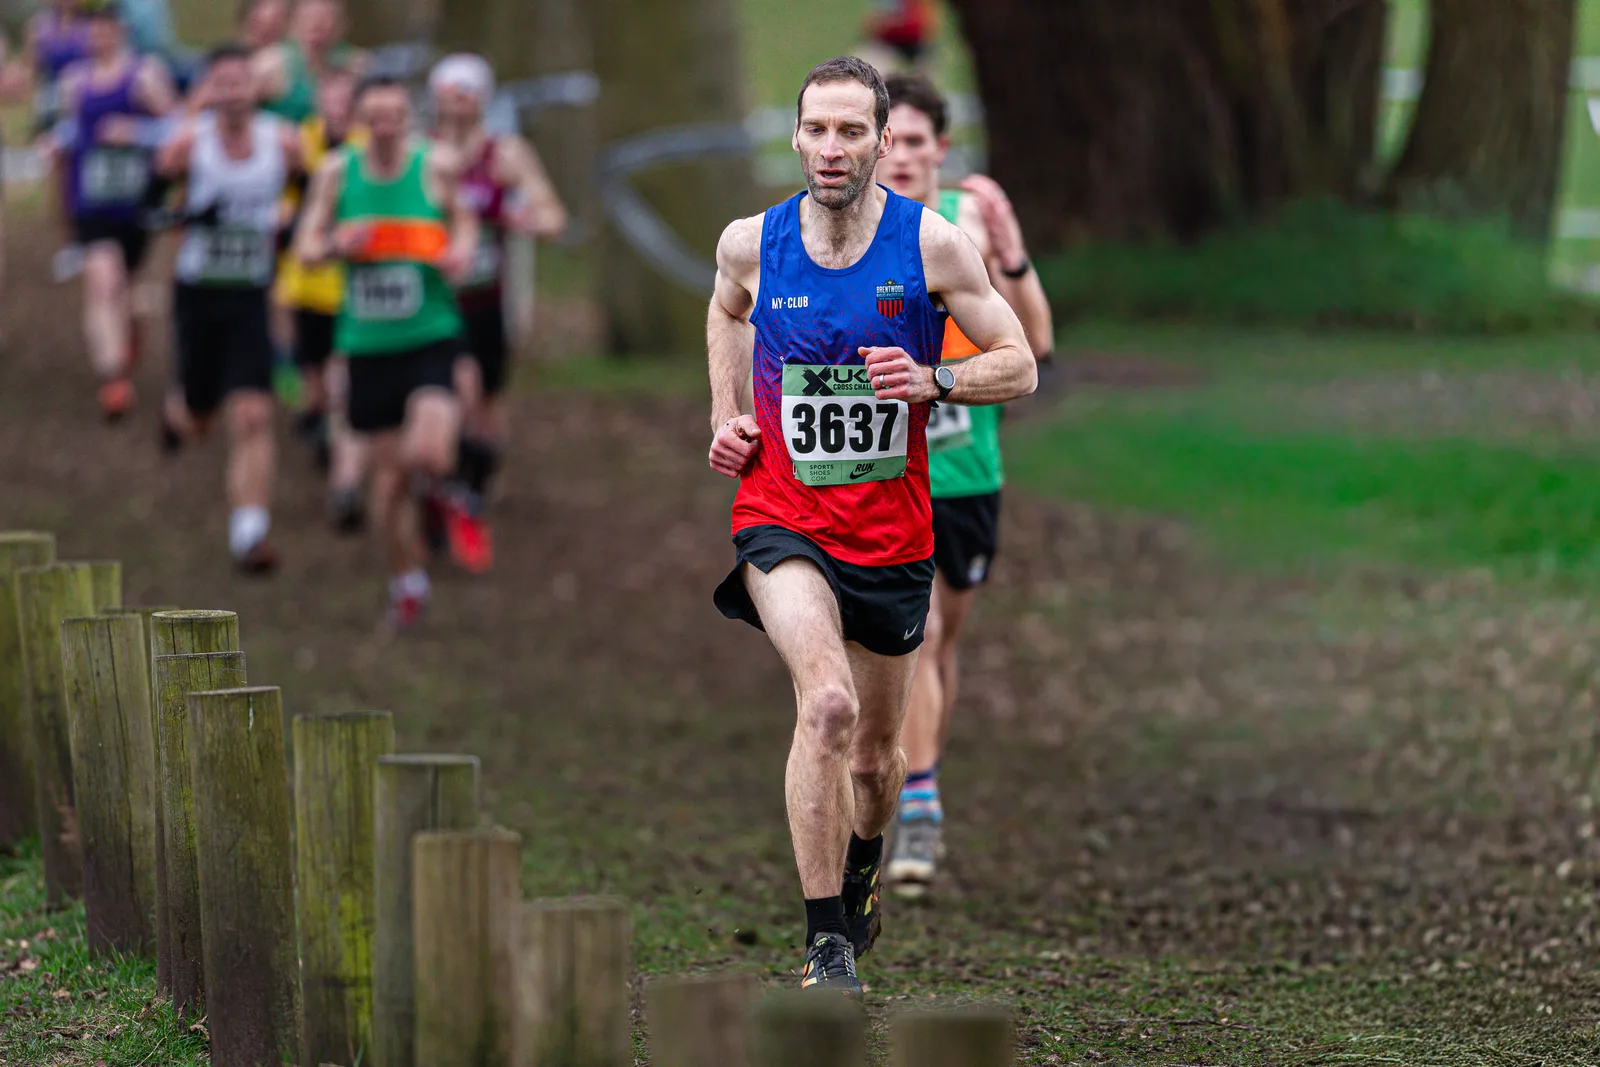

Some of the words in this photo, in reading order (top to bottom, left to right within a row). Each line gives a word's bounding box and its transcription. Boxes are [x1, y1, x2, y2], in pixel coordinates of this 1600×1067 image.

[876, 284, 905, 294] BRENTWOOD
[791, 403, 899, 454] 3637
[855, 462, 875, 472] RUN
